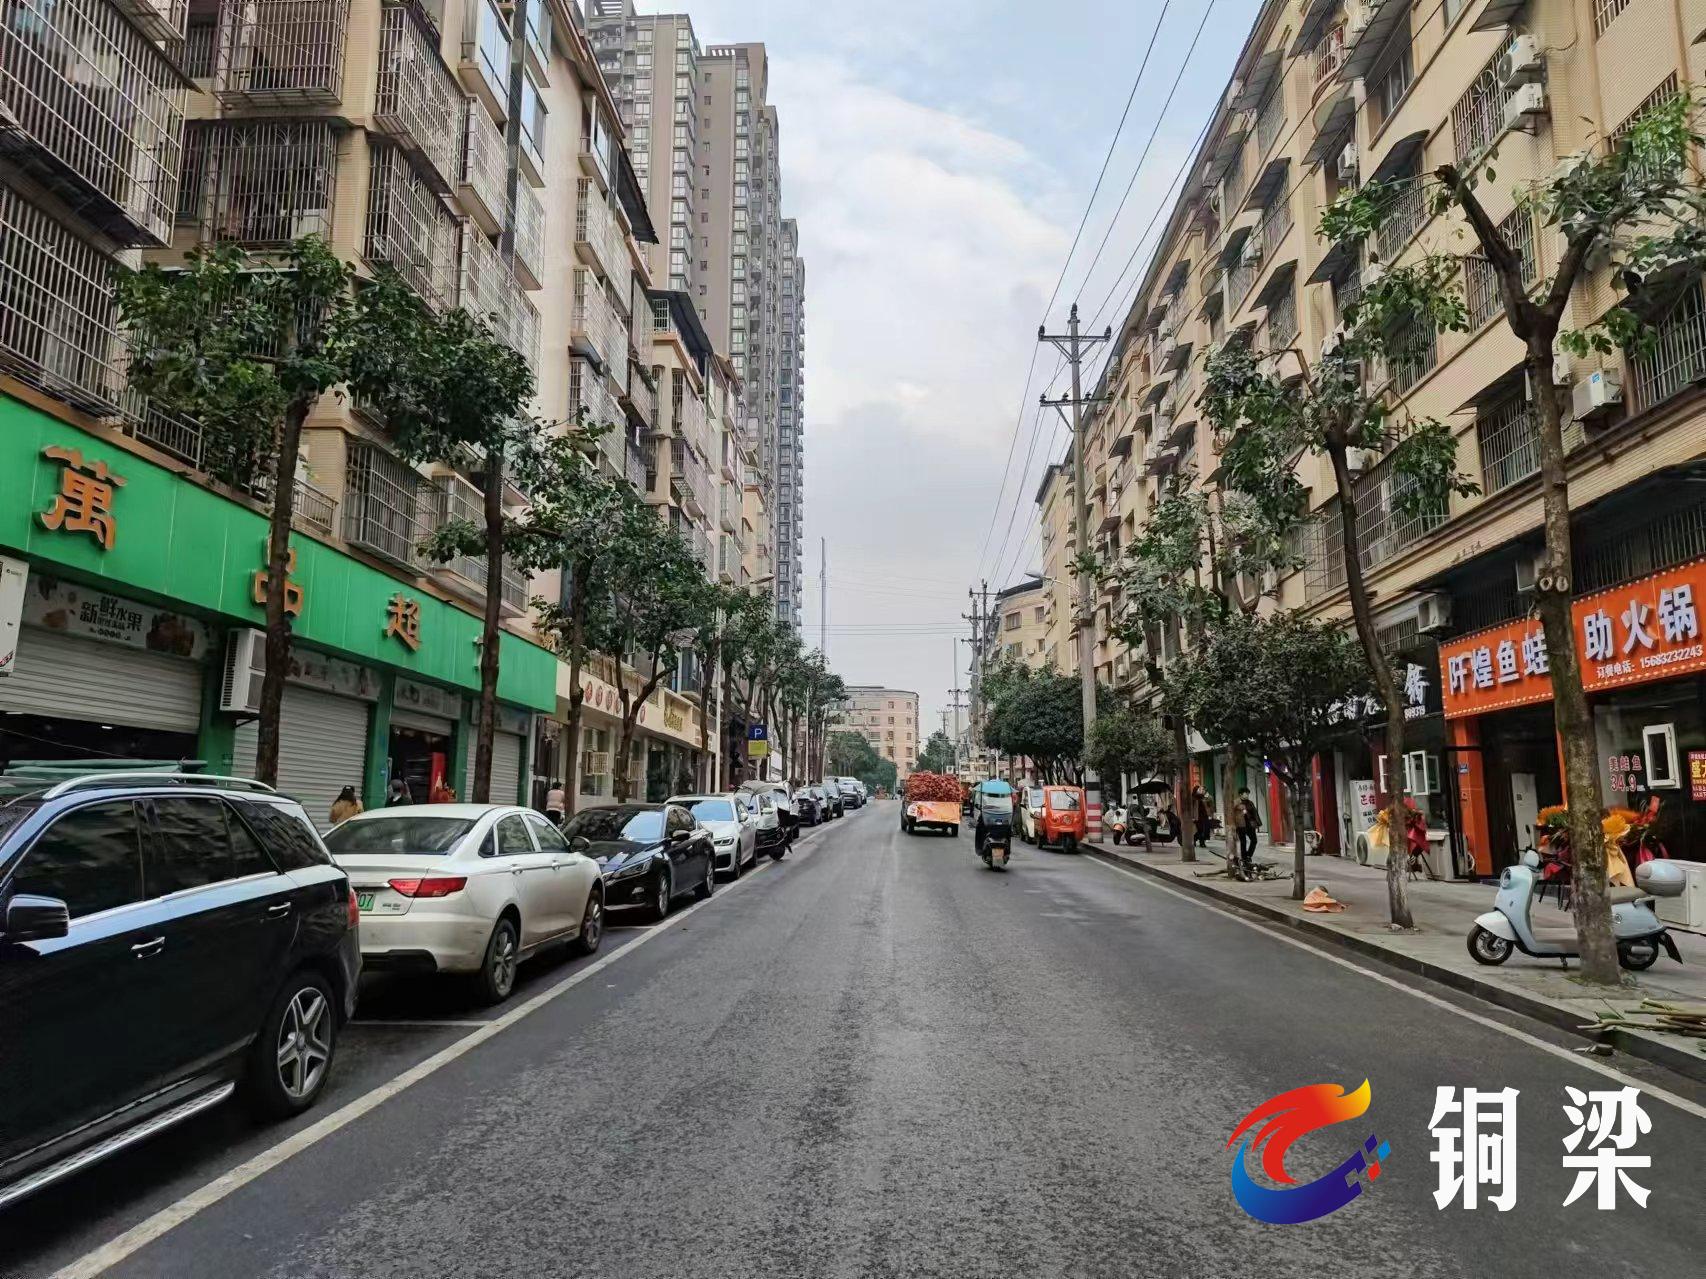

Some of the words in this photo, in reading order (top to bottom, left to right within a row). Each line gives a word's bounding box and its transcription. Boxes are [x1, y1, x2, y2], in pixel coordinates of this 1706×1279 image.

[80, 597, 143, 632] 新鲜水果
[754, 728, 763, 739] P
[1610, 774, 1637, 792] 34.9
